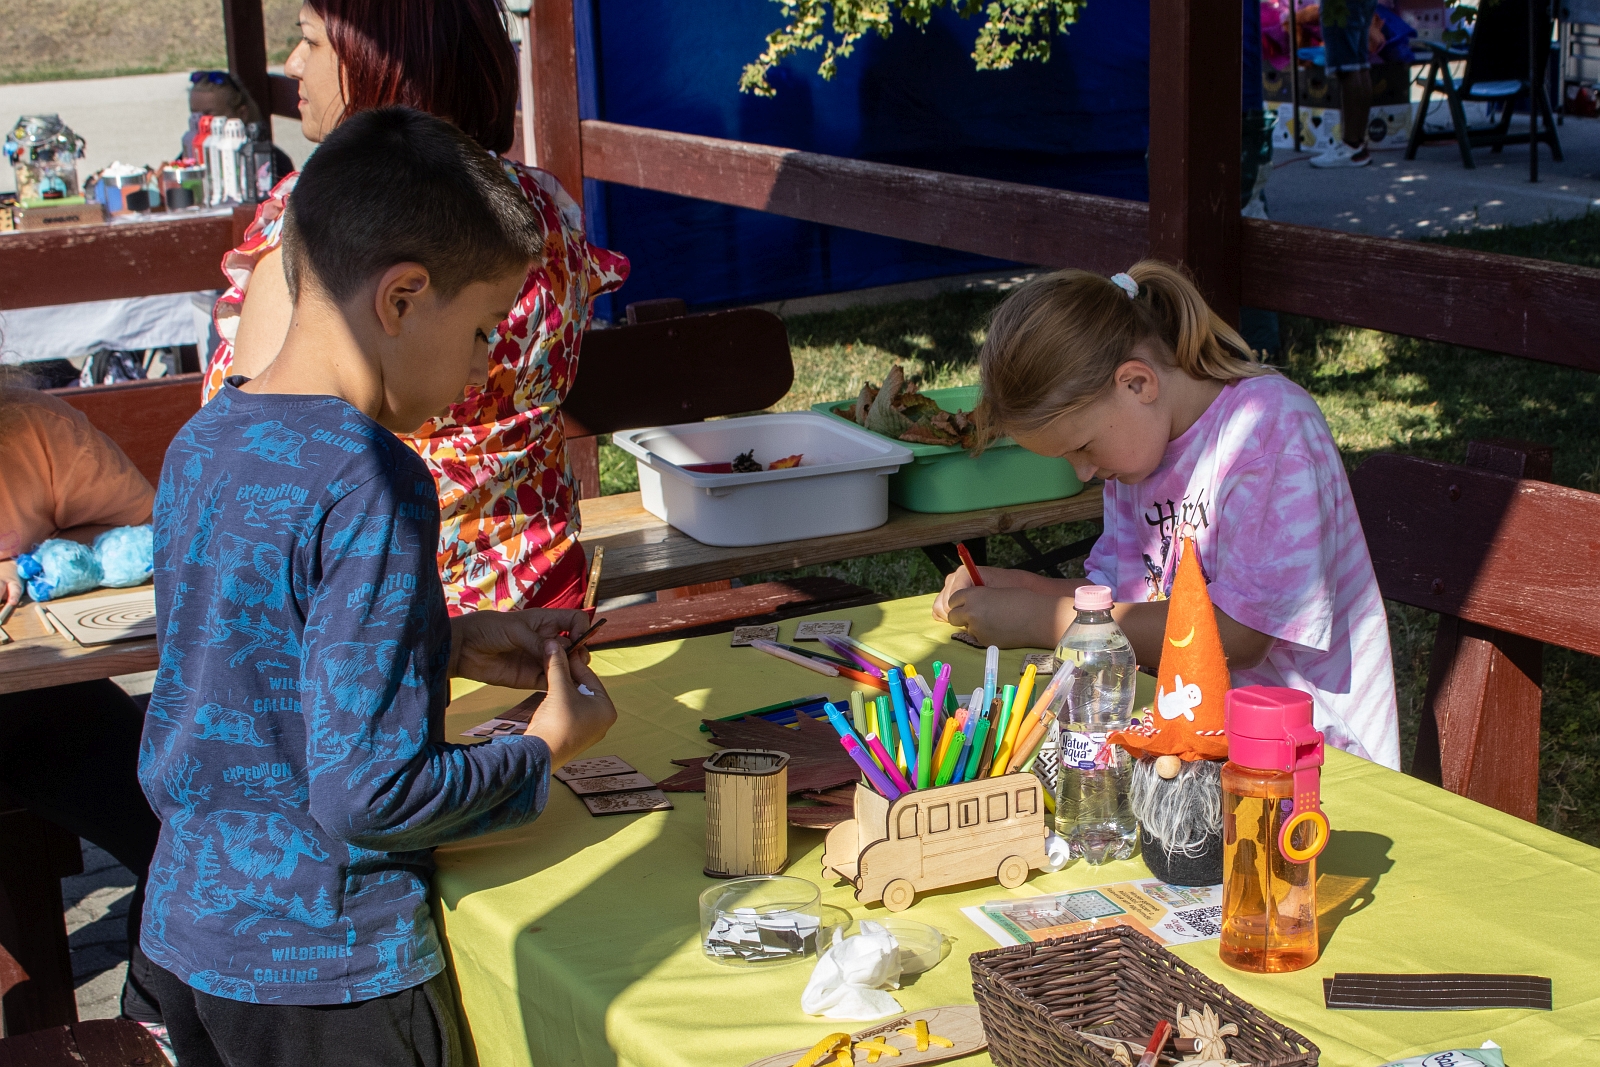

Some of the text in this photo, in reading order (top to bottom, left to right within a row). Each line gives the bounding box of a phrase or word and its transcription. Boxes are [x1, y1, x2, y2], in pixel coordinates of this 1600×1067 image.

[311, 429, 368, 454] CALLING
[236, 483, 310, 504] EXPEDITION
[346, 572, 418, 609] EXPITION
[1062, 735, 1089, 750] Natur
[1063, 747, 1087, 762] aqua
[222, 762, 293, 783] EXPEDIION
[253, 967, 319, 984] CALLING
